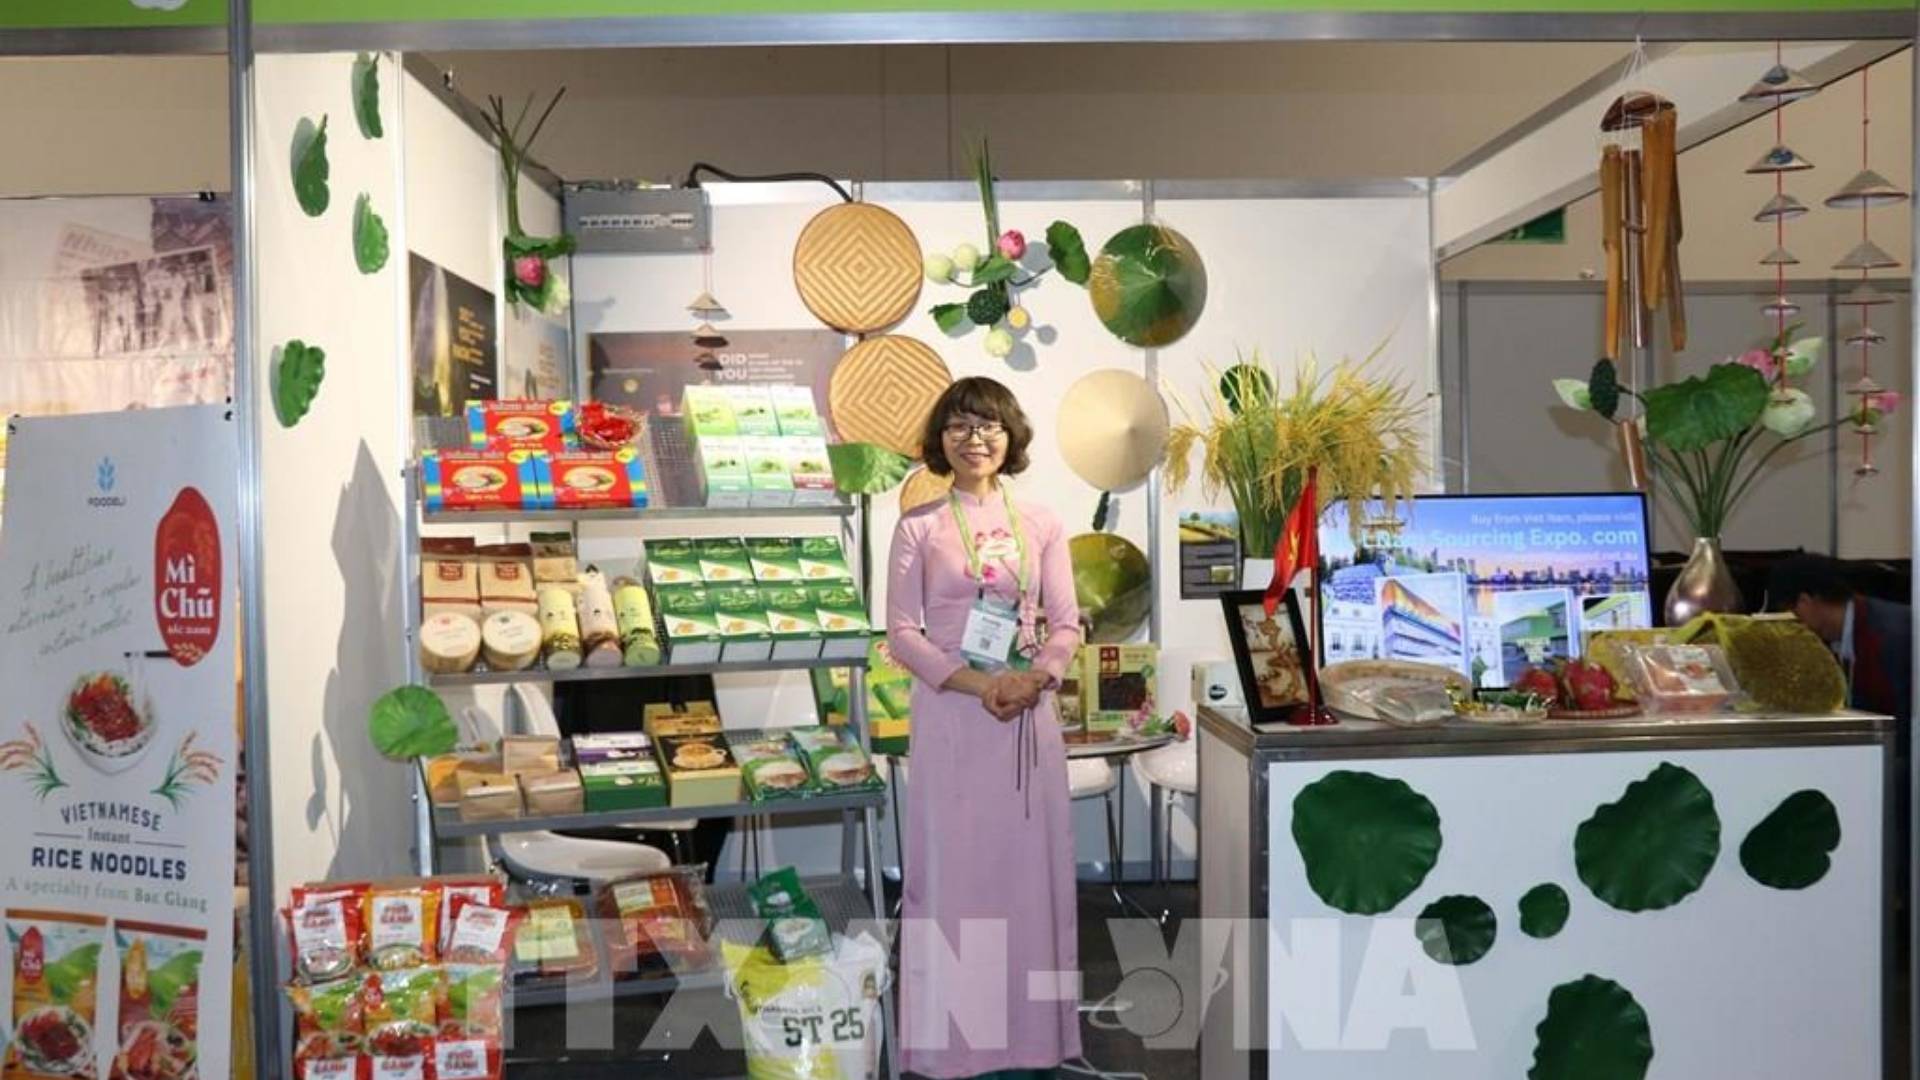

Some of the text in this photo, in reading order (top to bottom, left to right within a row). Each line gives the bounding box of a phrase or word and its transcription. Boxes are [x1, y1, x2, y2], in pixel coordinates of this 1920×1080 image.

[719, 353, 747, 365] DID
[716, 368, 748, 380] YOU
[1431, 529, 1526, 551] Sourcing
[1531, 528, 1588, 549] Expo.
[1592, 529, 1638, 545] com
[164, 553, 195, 584] Mì
[160, 586, 214, 619] Chũ
[61, 801, 162, 832] VIETNAMESE
[87, 826, 131, 844] Instant
[31, 846, 187, 881] RICE NOODLES
[5, 876, 18, 891] A
[24, 878, 90, 898] specialty
[95, 881, 129, 900] from
[782, 1006, 865, 1047] ST 25
